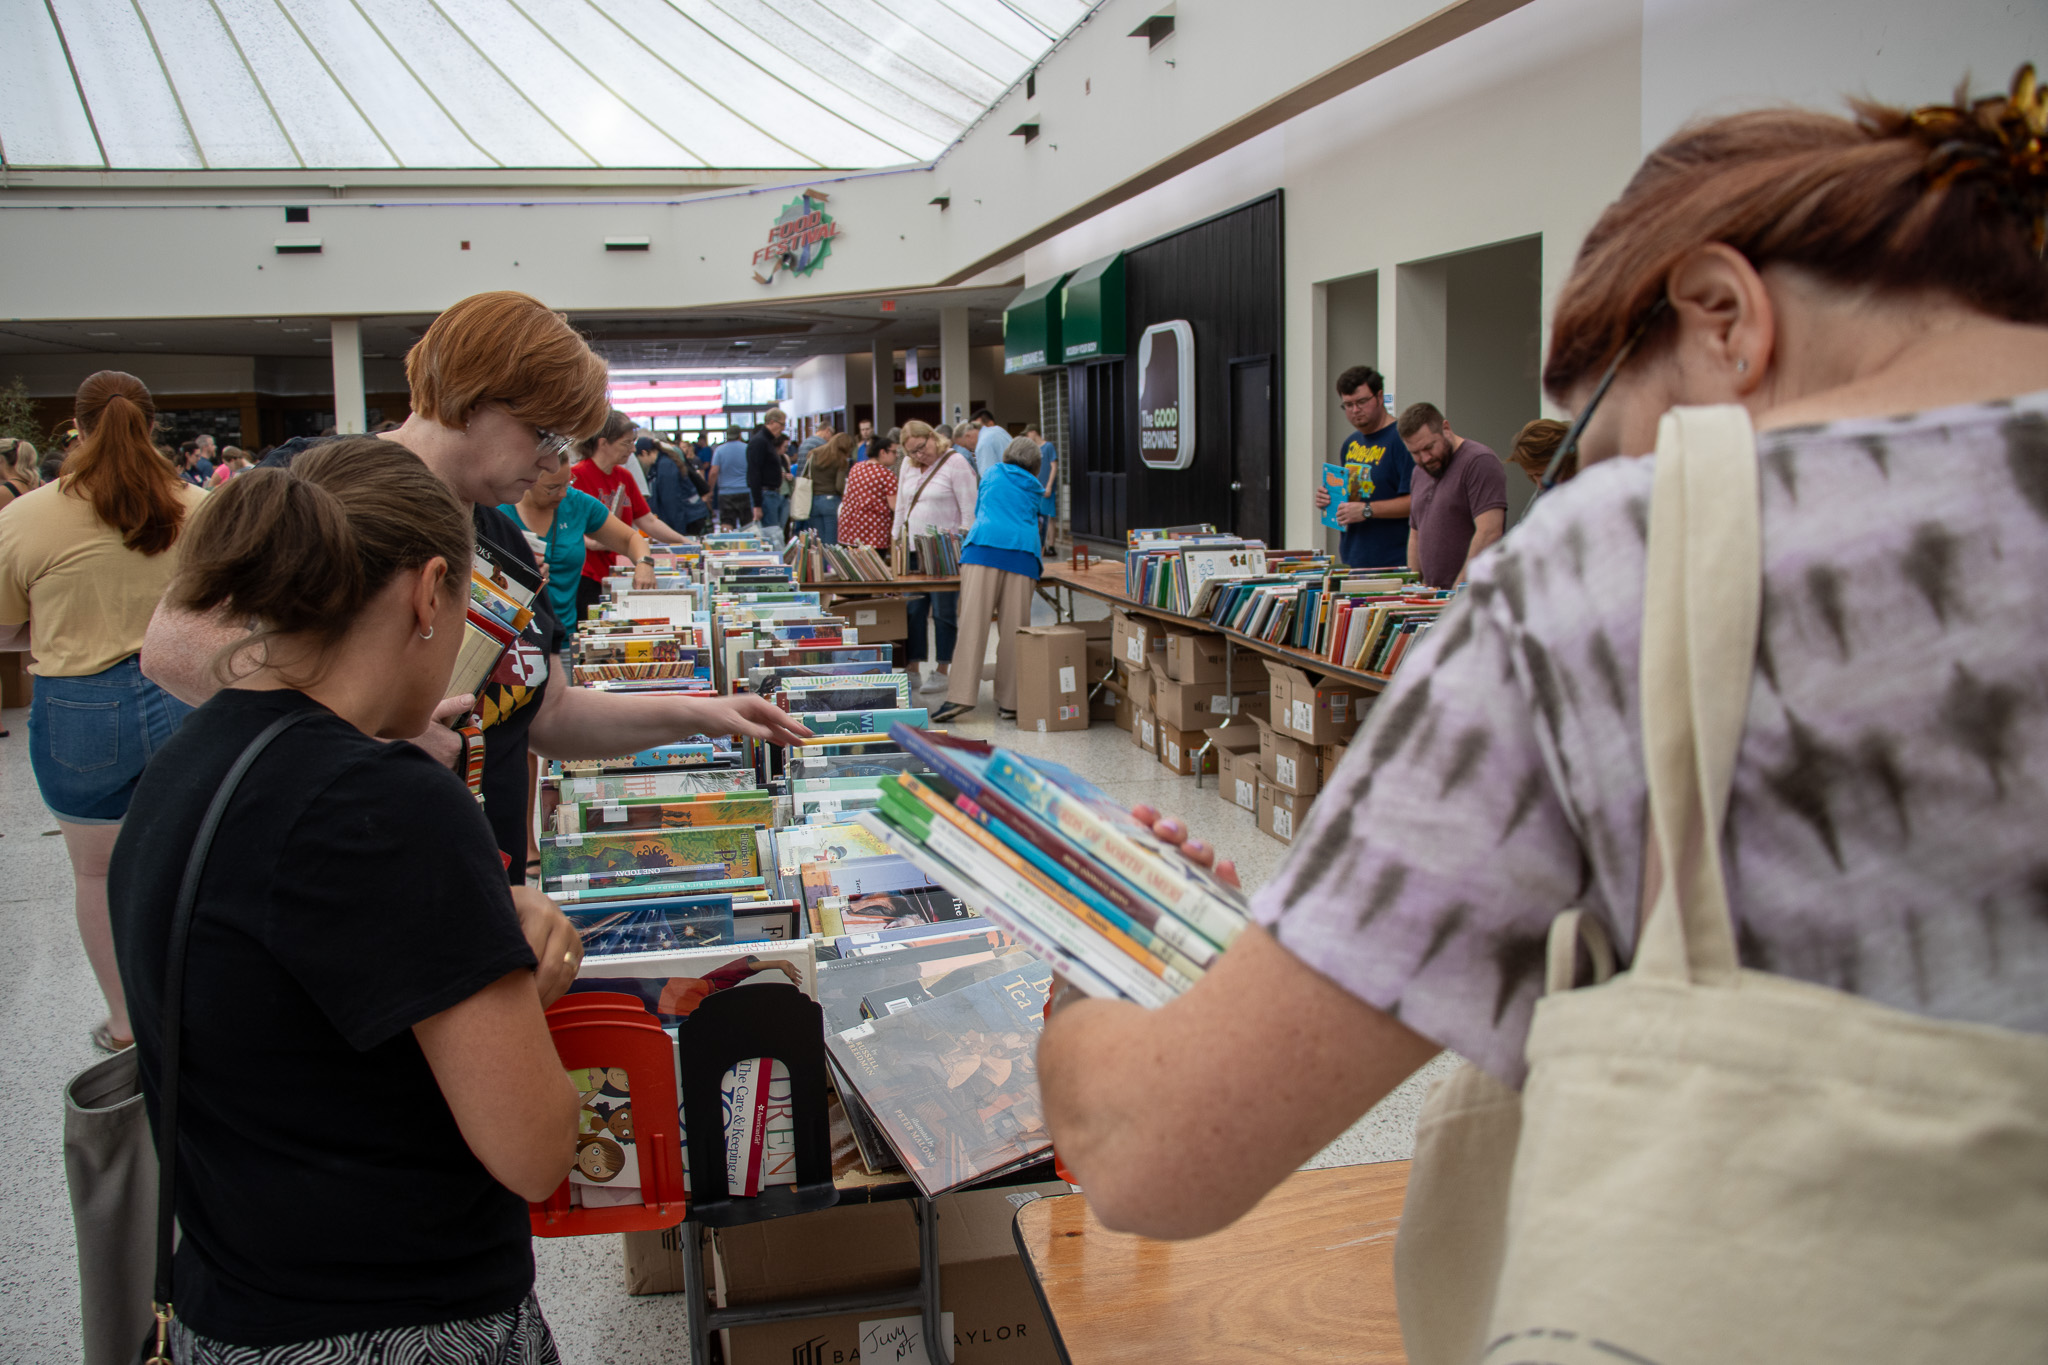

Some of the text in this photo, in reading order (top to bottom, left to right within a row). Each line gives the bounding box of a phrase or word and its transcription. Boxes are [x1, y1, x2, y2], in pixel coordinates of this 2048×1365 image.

[768, 210, 821, 242] FOOD
[752, 222, 841, 266] FESTIVAL
[1142, 407, 1177, 428] The GOOD
[1142, 431, 1177, 449] BROWNIE
[474, 544, 492, 560] OKS
[714, 849, 737, 879] Pr
[741, 833, 749, 868] Elizabeth
[1080, 820, 1106, 846] OF
[1099, 833, 1149, 877] NORTH
[1142, 865, 1186, 905] AMERI
[615, 869, 642, 877] TODAY
[952, 897, 962, 917] The
[1002, 974, 1031, 1010] Tea
[847, 1041, 874, 1077] FREEDMAN
[855, 1040, 879, 1070] RUSSELL
[737, 1060, 752, 1084] The
[735, 1085, 749, 1113] Care
[733, 1115, 746, 1126] &
[766, 1076, 796, 1177] DREN
[895, 1108, 937, 1163] PETER MALONE
[727, 1128, 744, 1173] Keeping
[727, 1174, 738, 1185] of
[863, 1325, 909, 1354] Juvy
[954, 1324, 1027, 1345] AYLOR
[834, 1349, 860, 1364] BA
